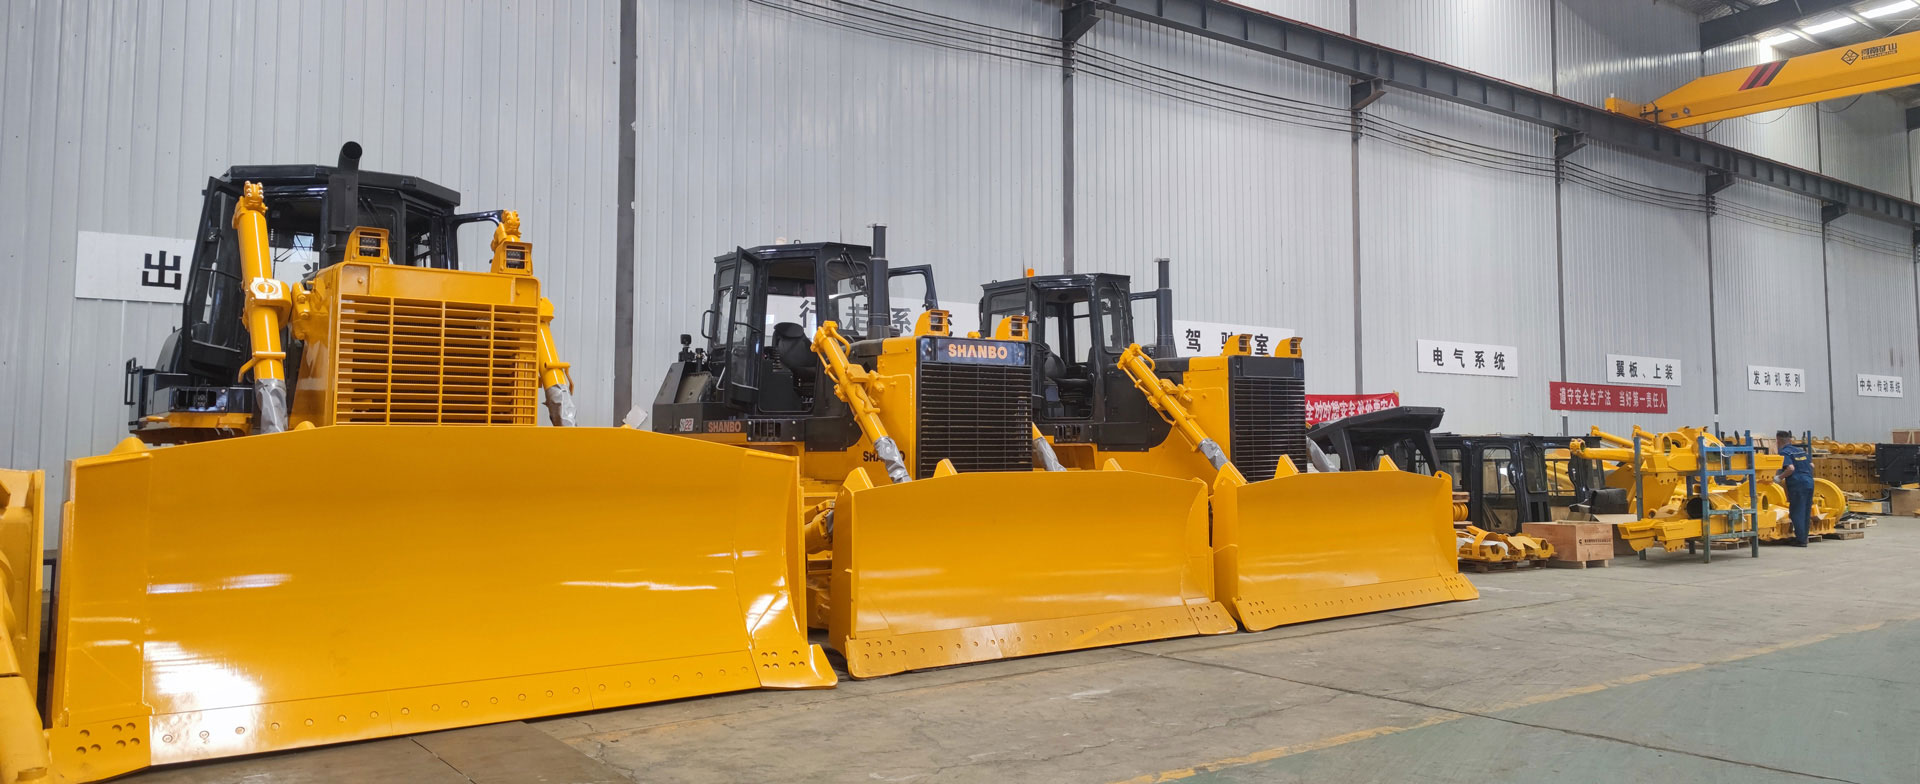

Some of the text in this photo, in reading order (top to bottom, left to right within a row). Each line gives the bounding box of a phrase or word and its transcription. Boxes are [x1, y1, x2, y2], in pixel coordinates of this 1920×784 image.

[141, 250, 182, 291] 出
[948, 343, 1008, 360] SHANBO
[1432, 346, 1506, 370] 电气系统
[1616, 360, 1673, 380] 翼板、上装
[1753, 370, 1801, 387] 发动机系列
[1559, 386, 1666, 408] 遵守安全生产法 当好第一责任人
[708, 421, 742, 433] SHANBO
